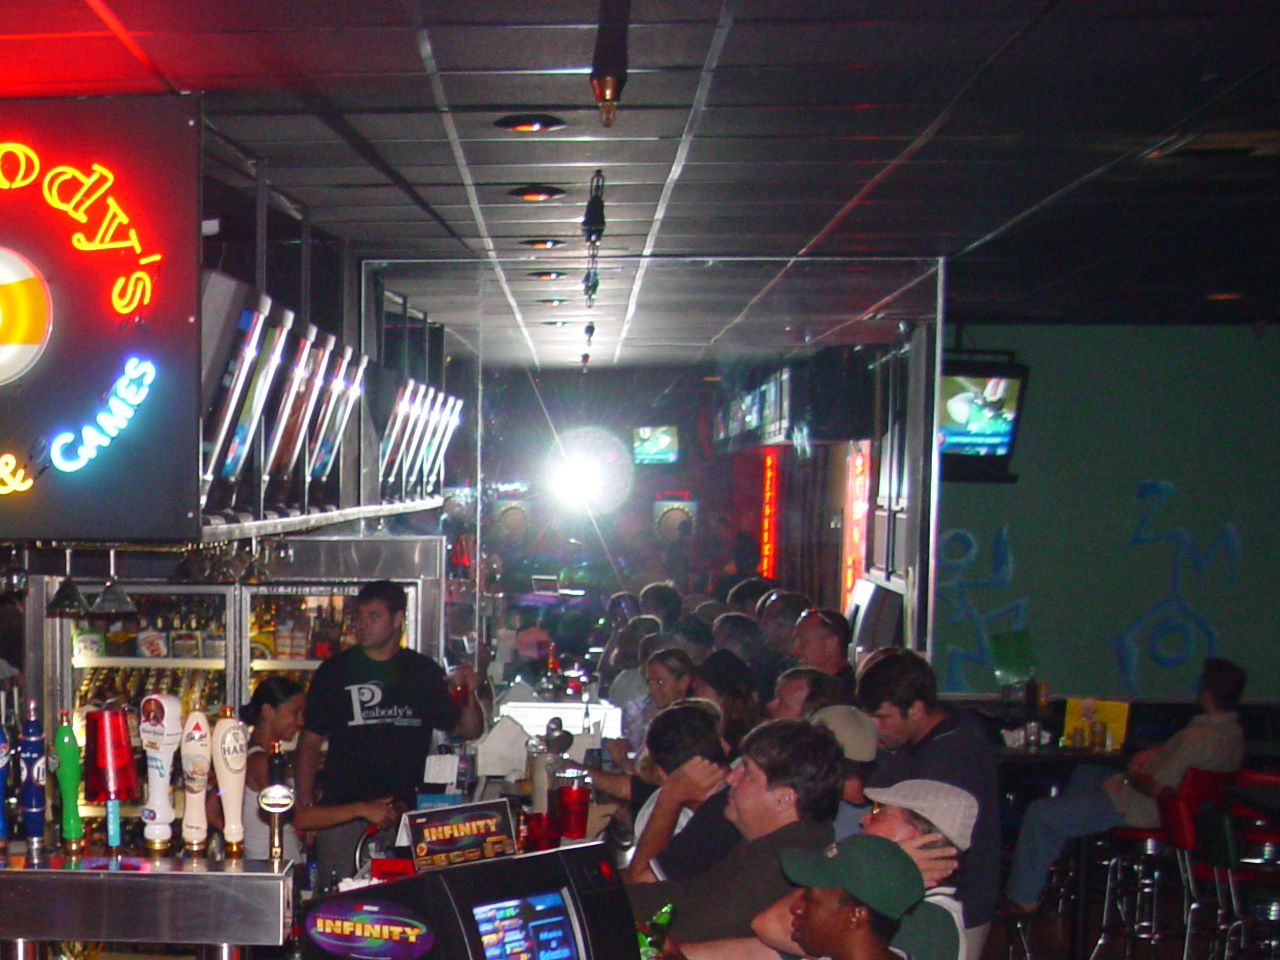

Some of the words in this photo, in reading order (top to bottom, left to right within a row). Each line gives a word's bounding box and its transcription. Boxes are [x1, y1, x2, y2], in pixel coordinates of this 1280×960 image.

[50, 356, 157, 472] GAMES
[344, 683, 413, 726] Peabody's
[423, 817, 498, 842] INFINITY
[315, 918, 422, 943] INFINITY
